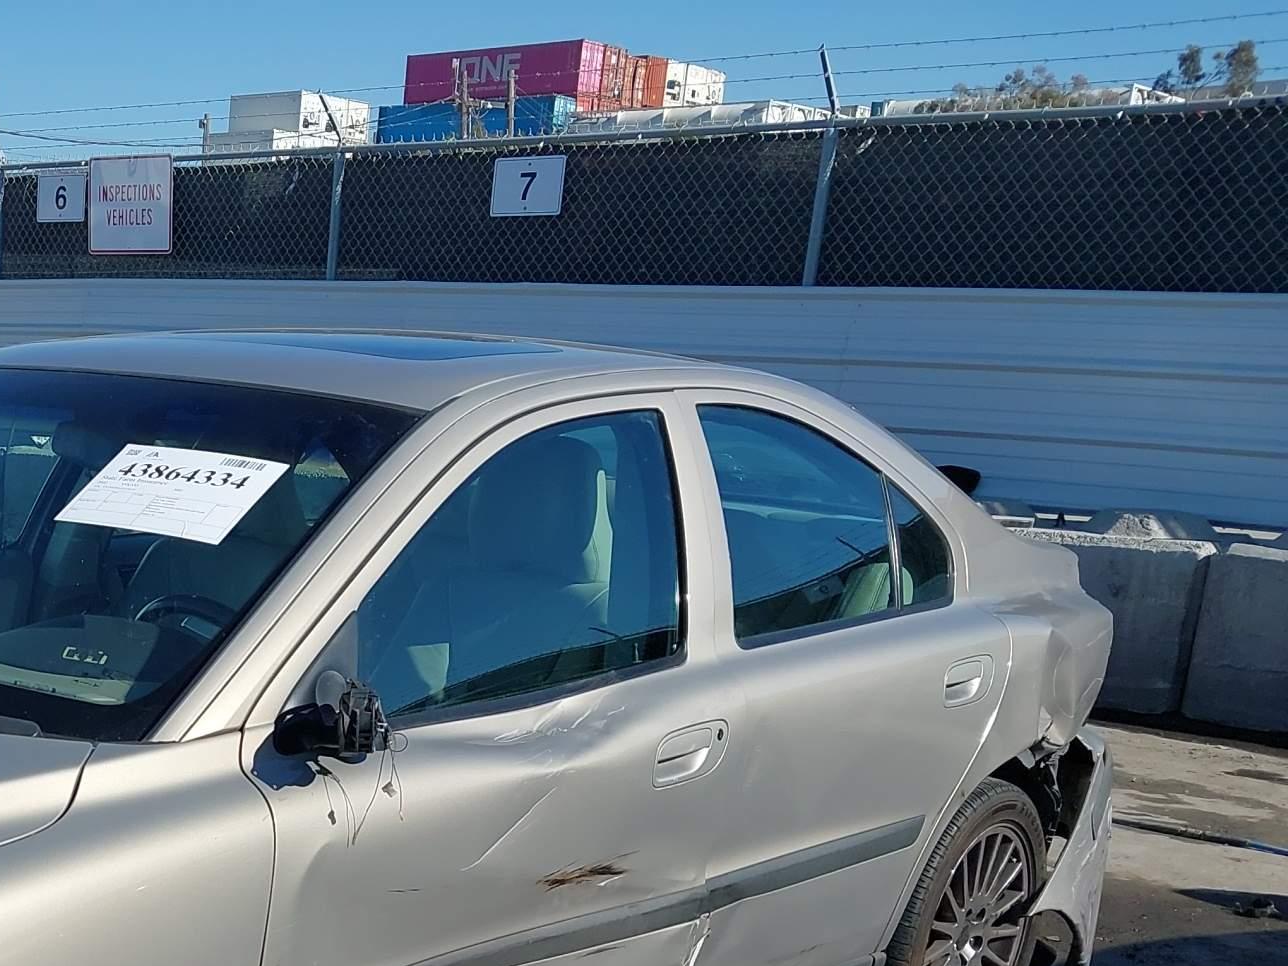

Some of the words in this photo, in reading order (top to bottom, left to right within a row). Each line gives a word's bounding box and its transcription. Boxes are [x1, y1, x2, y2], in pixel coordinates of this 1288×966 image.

[55, 185, 67, 210] 6
[98, 183, 162, 203] INSPECTIONS
[520, 172, 537, 201] 7
[106, 208, 153, 226] VEHICLES
[118, 462, 251, 490] 43864334
